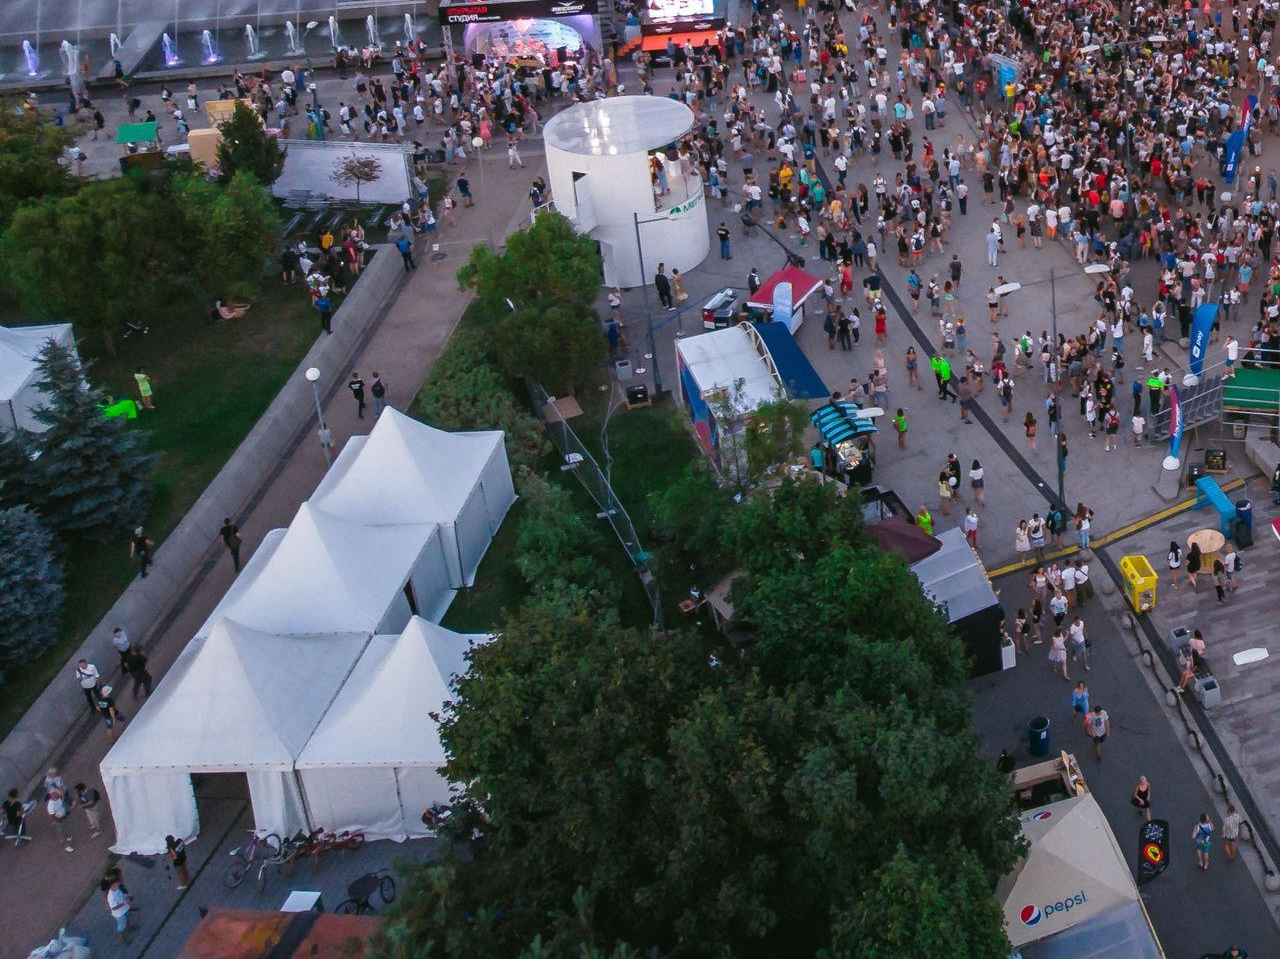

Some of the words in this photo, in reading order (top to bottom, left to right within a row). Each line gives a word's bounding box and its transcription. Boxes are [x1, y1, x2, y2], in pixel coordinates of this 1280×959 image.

[552, 4, 584, 12] RECORD
[448, 14, 479, 23] СТУДИЯ
[1044, 890, 1088, 919] pepsi
